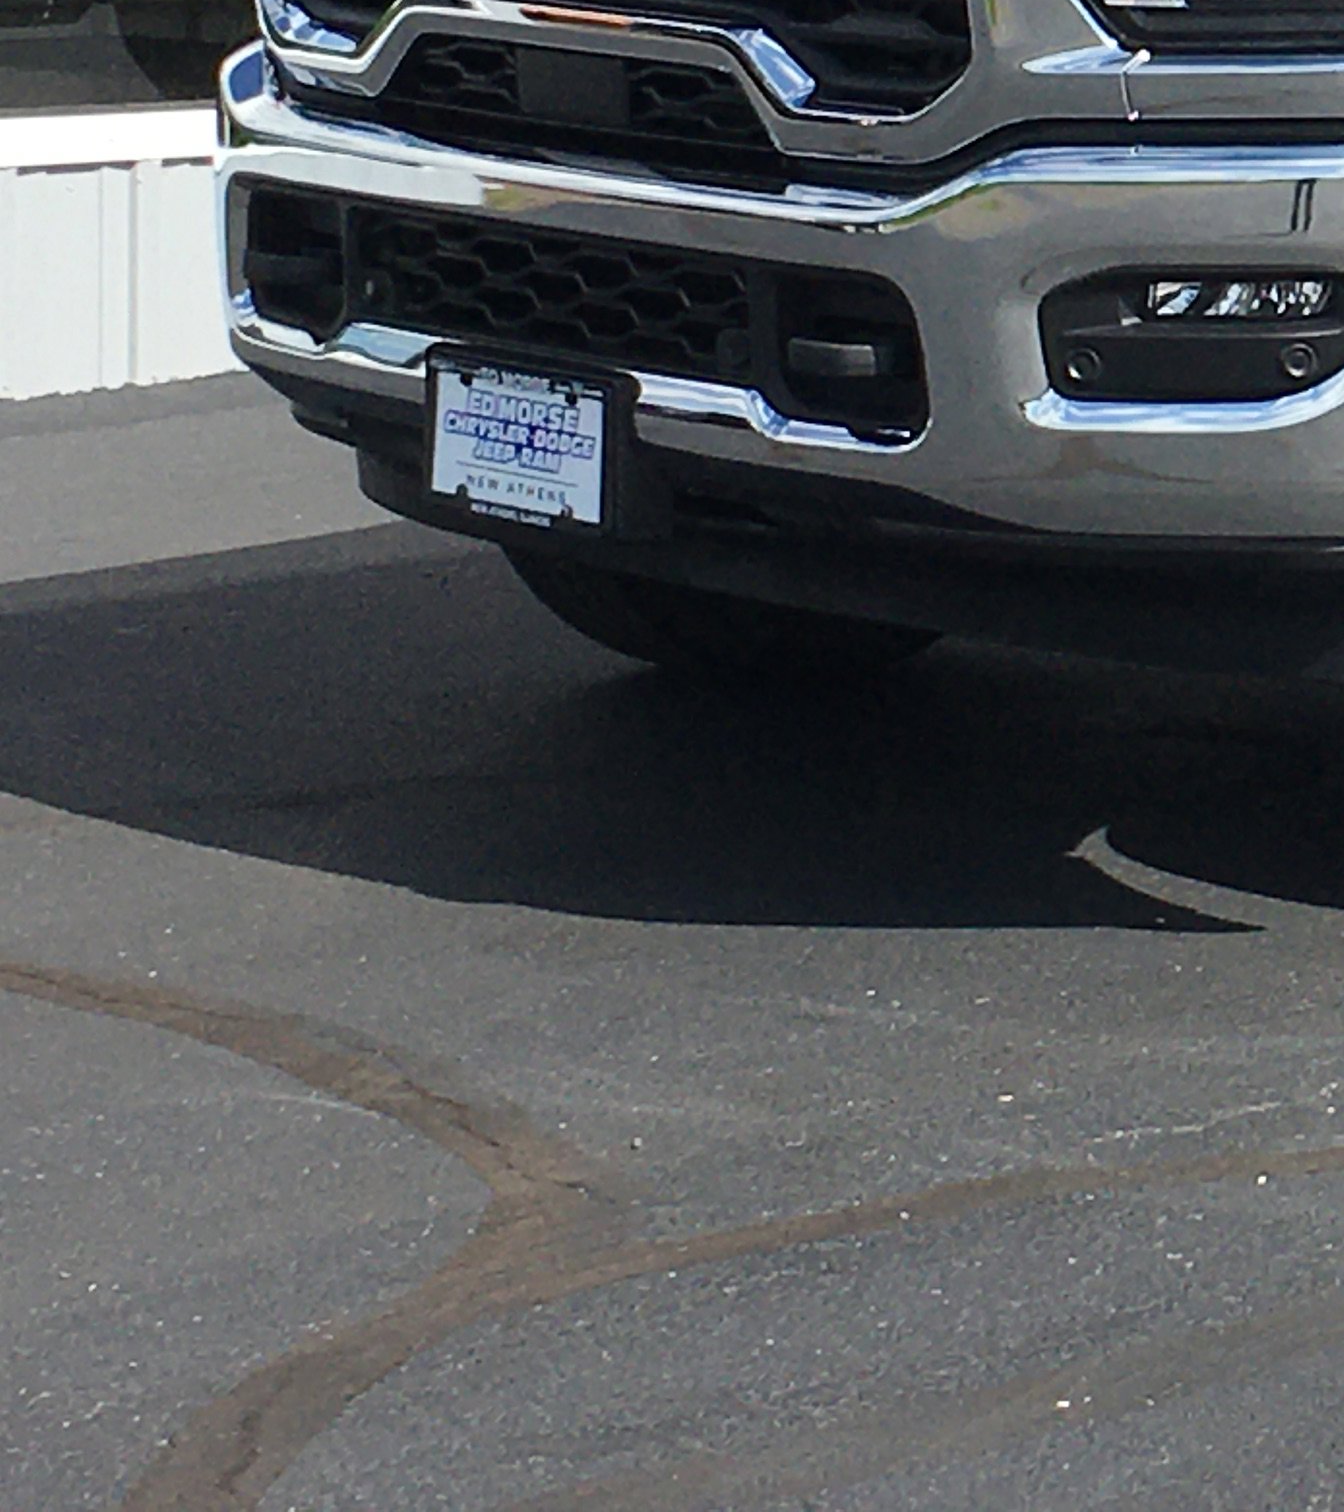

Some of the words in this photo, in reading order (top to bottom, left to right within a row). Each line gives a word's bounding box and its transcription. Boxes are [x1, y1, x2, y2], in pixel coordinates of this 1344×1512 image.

[468, 388, 497, 414] ED
[499, 395, 580, 433] MORSE
[474, 438, 516, 464] JEEP
[518, 449, 562, 474] RAM
[466, 474, 499, 491] NEW
